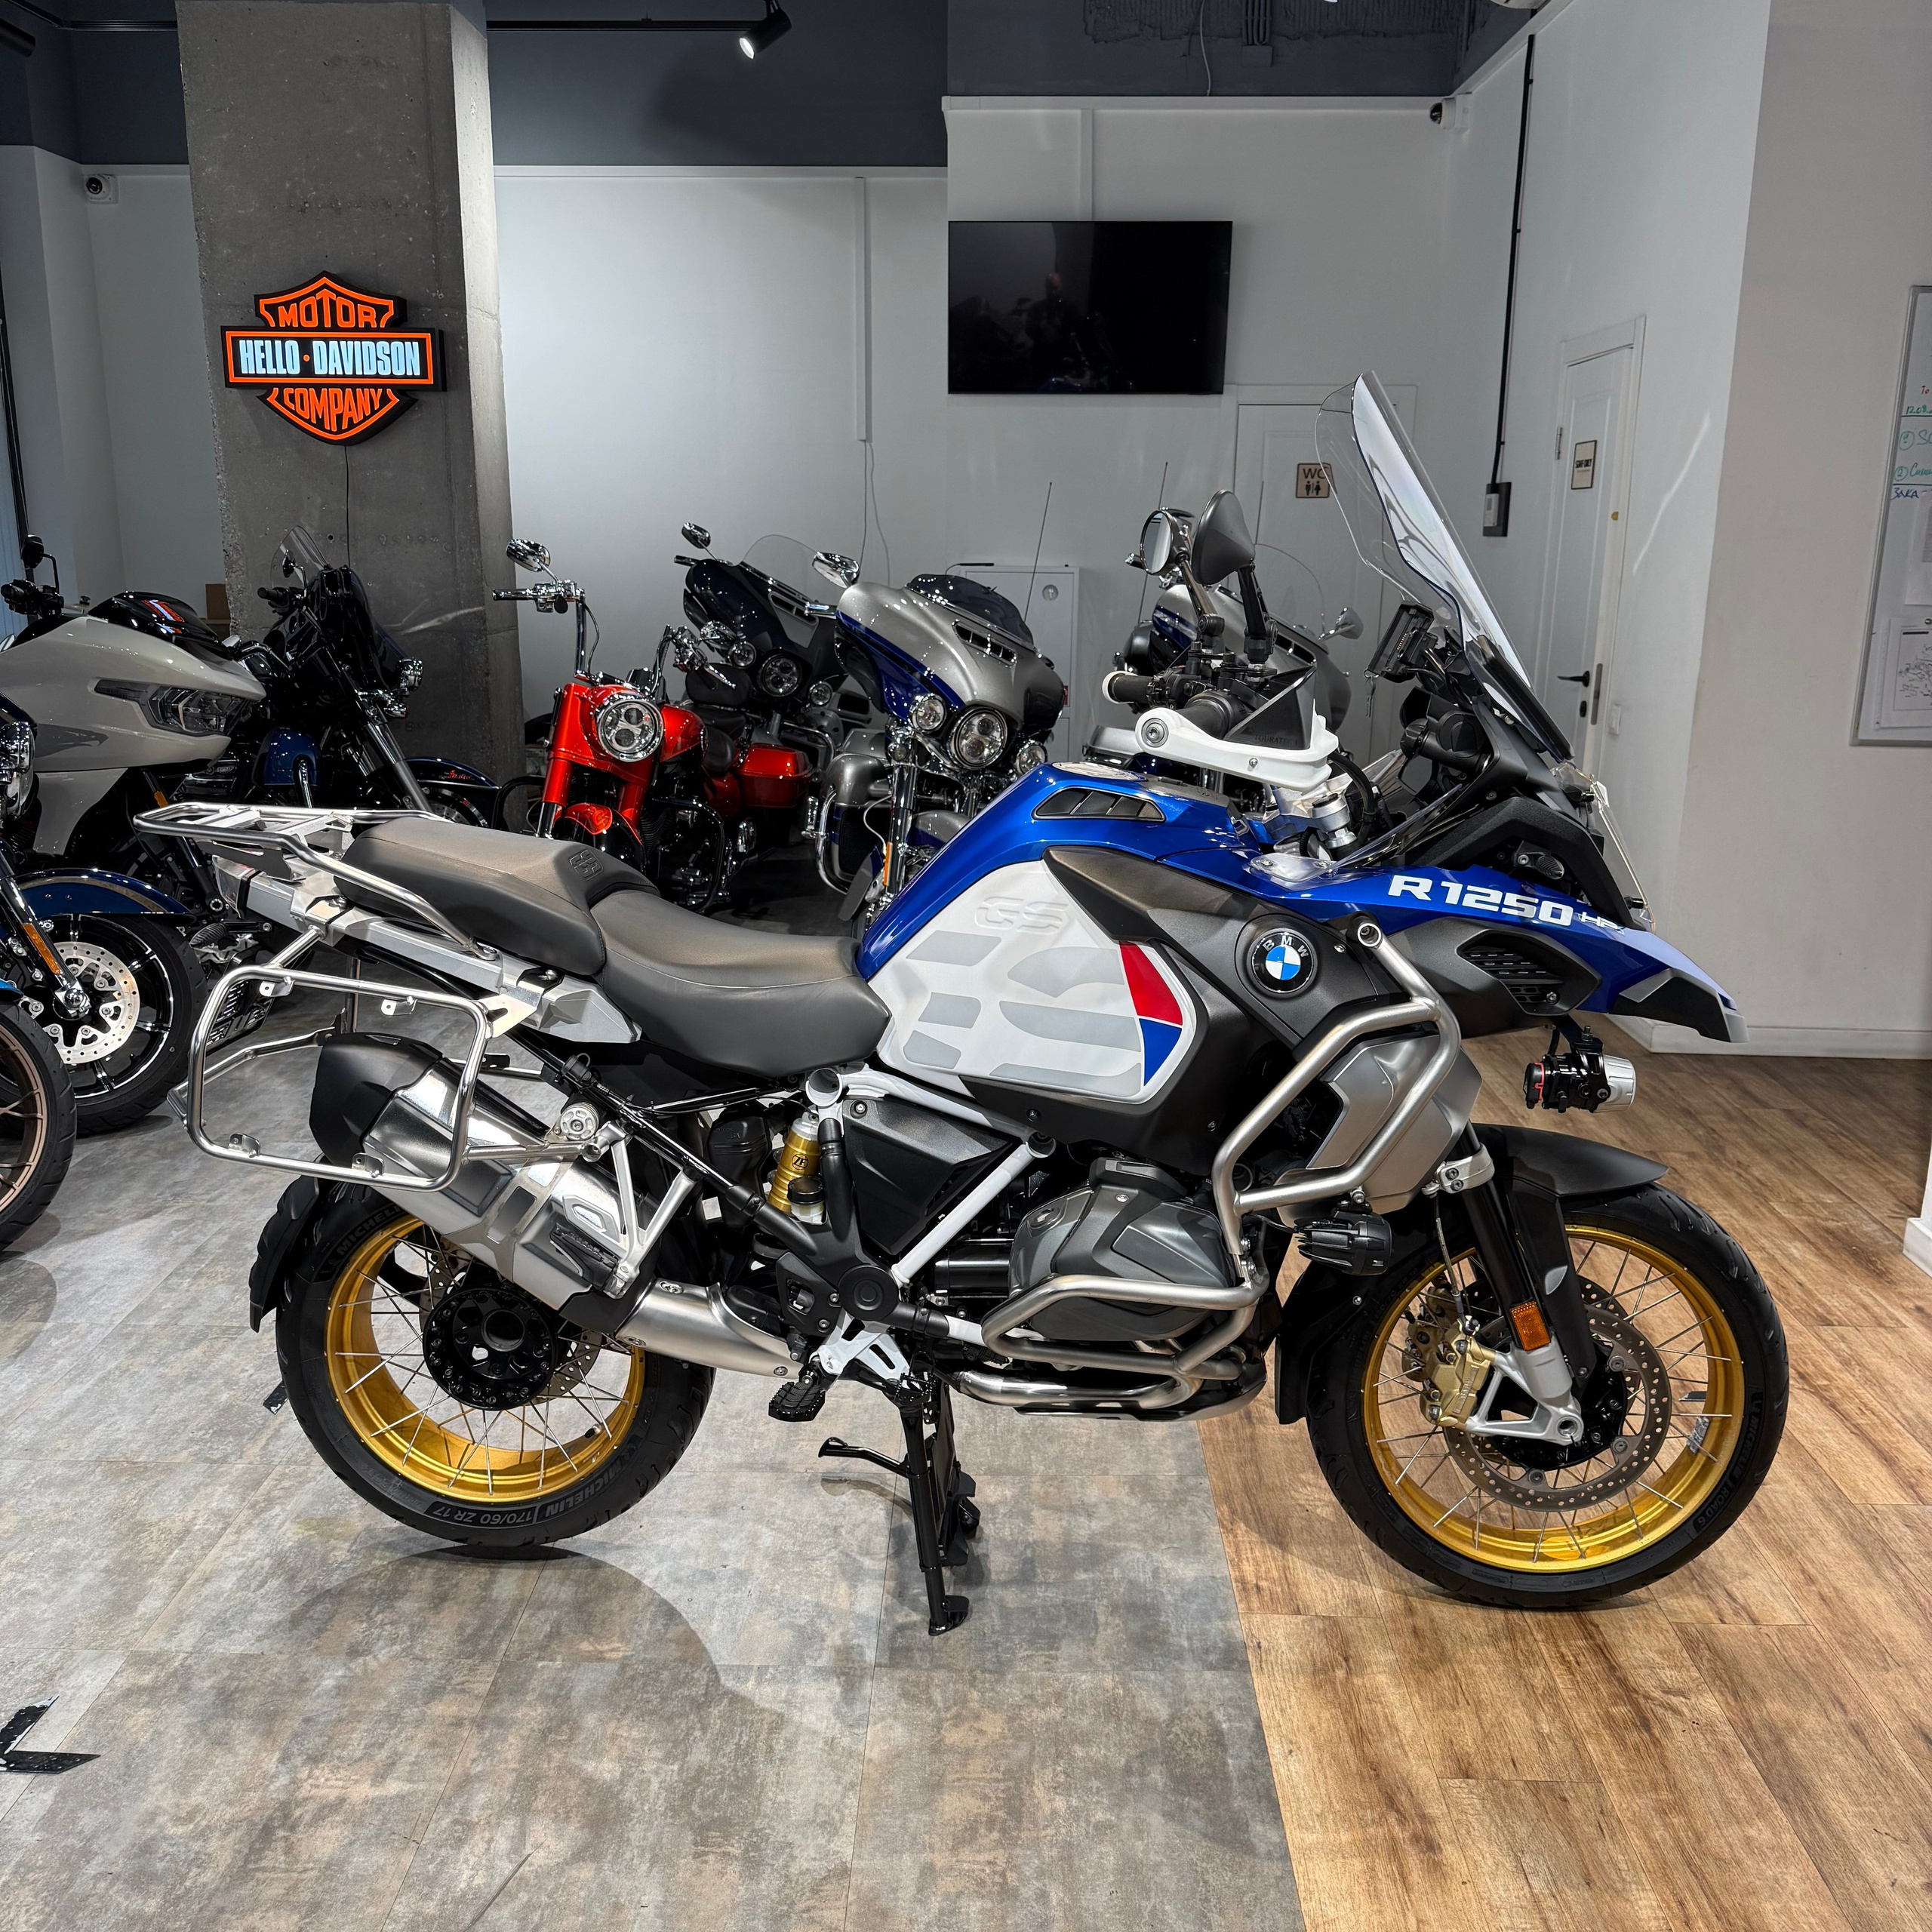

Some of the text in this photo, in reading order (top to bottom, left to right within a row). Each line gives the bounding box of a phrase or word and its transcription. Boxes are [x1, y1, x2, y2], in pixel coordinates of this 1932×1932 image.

[278, 288, 377, 328] MOTOR
[238, 340, 420, 375] HELLO DAVIDSON
[283, 387, 383, 432] COMPANY
[1303, 466, 1330, 479] WC
[974, 896, 1069, 936] GS
[1388, 874, 1433, 901] R
[1440, 881, 1574, 927] 1250
[1262, 935, 1309, 958] BMW
[336, 1205, 402, 1256] MICHELI
[432, 1459, 623, 1525] MICHELIN 170/60 ZR 17
